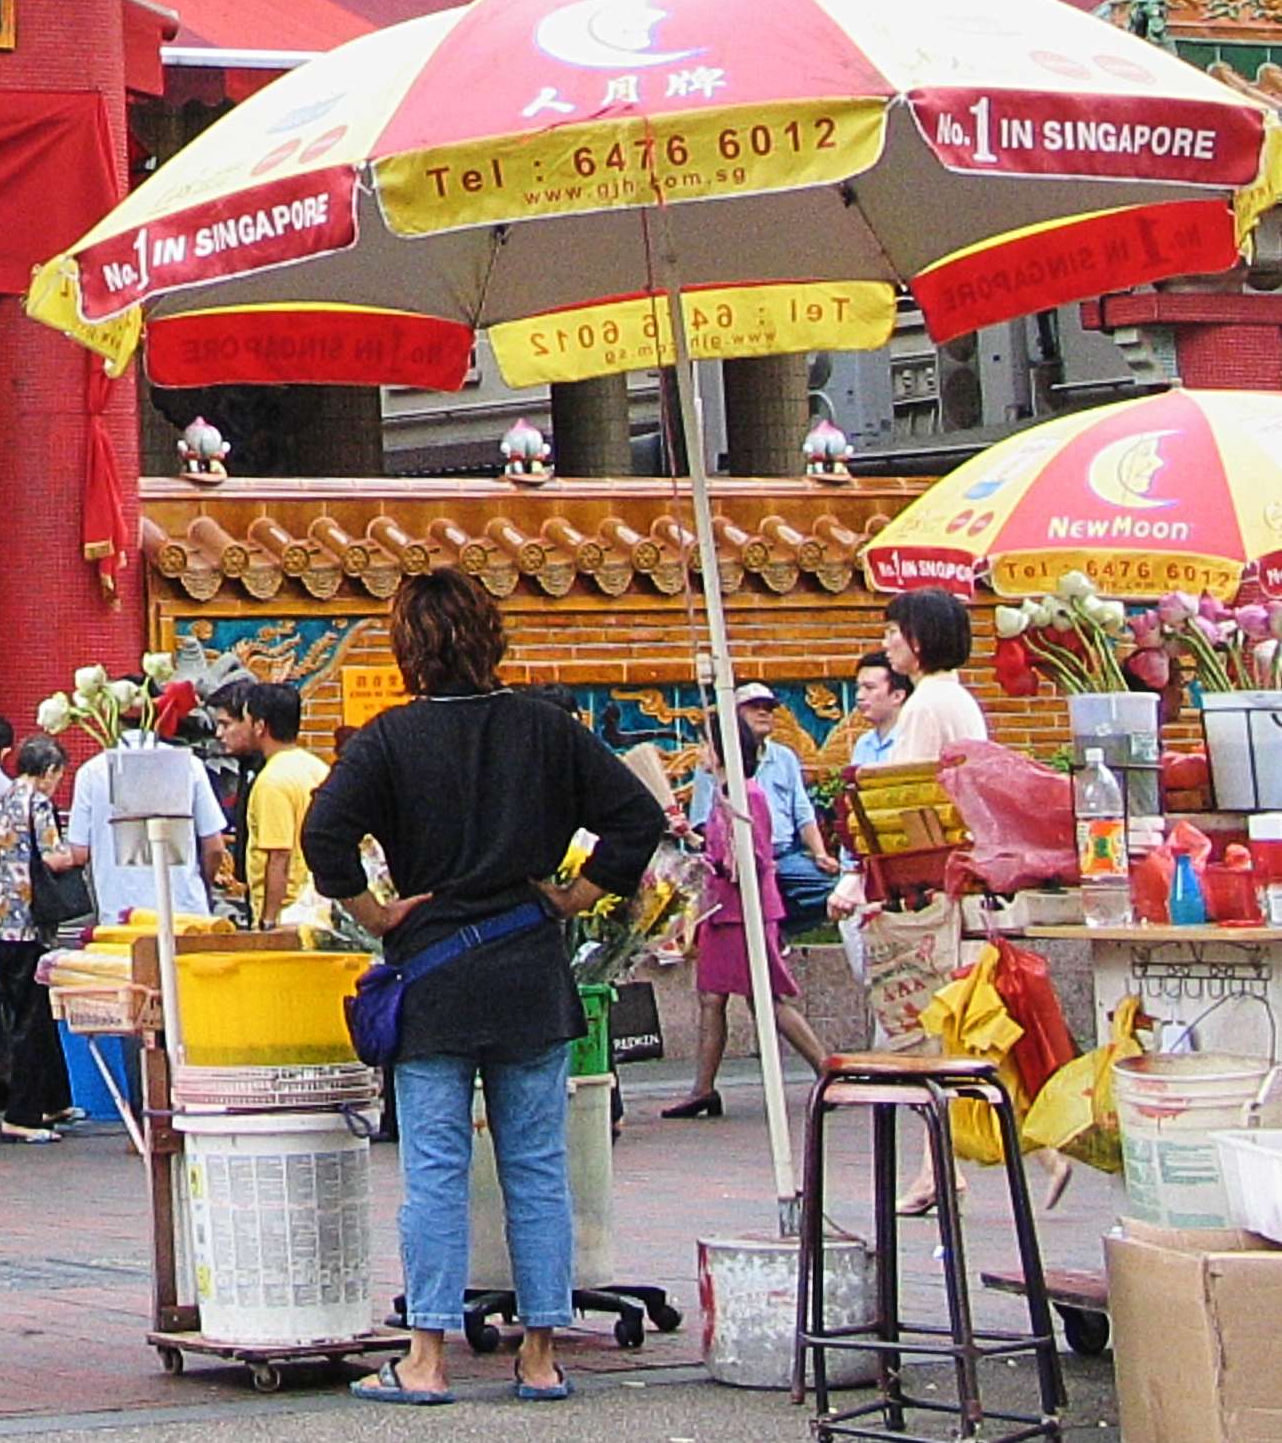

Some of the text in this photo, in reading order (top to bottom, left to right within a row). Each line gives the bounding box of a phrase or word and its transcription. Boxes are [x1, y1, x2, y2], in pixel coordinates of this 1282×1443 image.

[426, 159, 503, 197] Tel
[573, 135, 688, 177] 6476
[719, 117, 836, 159] 6012
[1000, 119, 1033, 149] IN
[1043, 120, 1216, 160] SINGAPORE
[153, 235, 185, 266] IN
[195, 193, 329, 257] SINGAPORE
[1005, 561, 1048, 579] Tel
[1087, 560, 1151, 579] 6476
[1166, 563, 1230, 587] 6012
